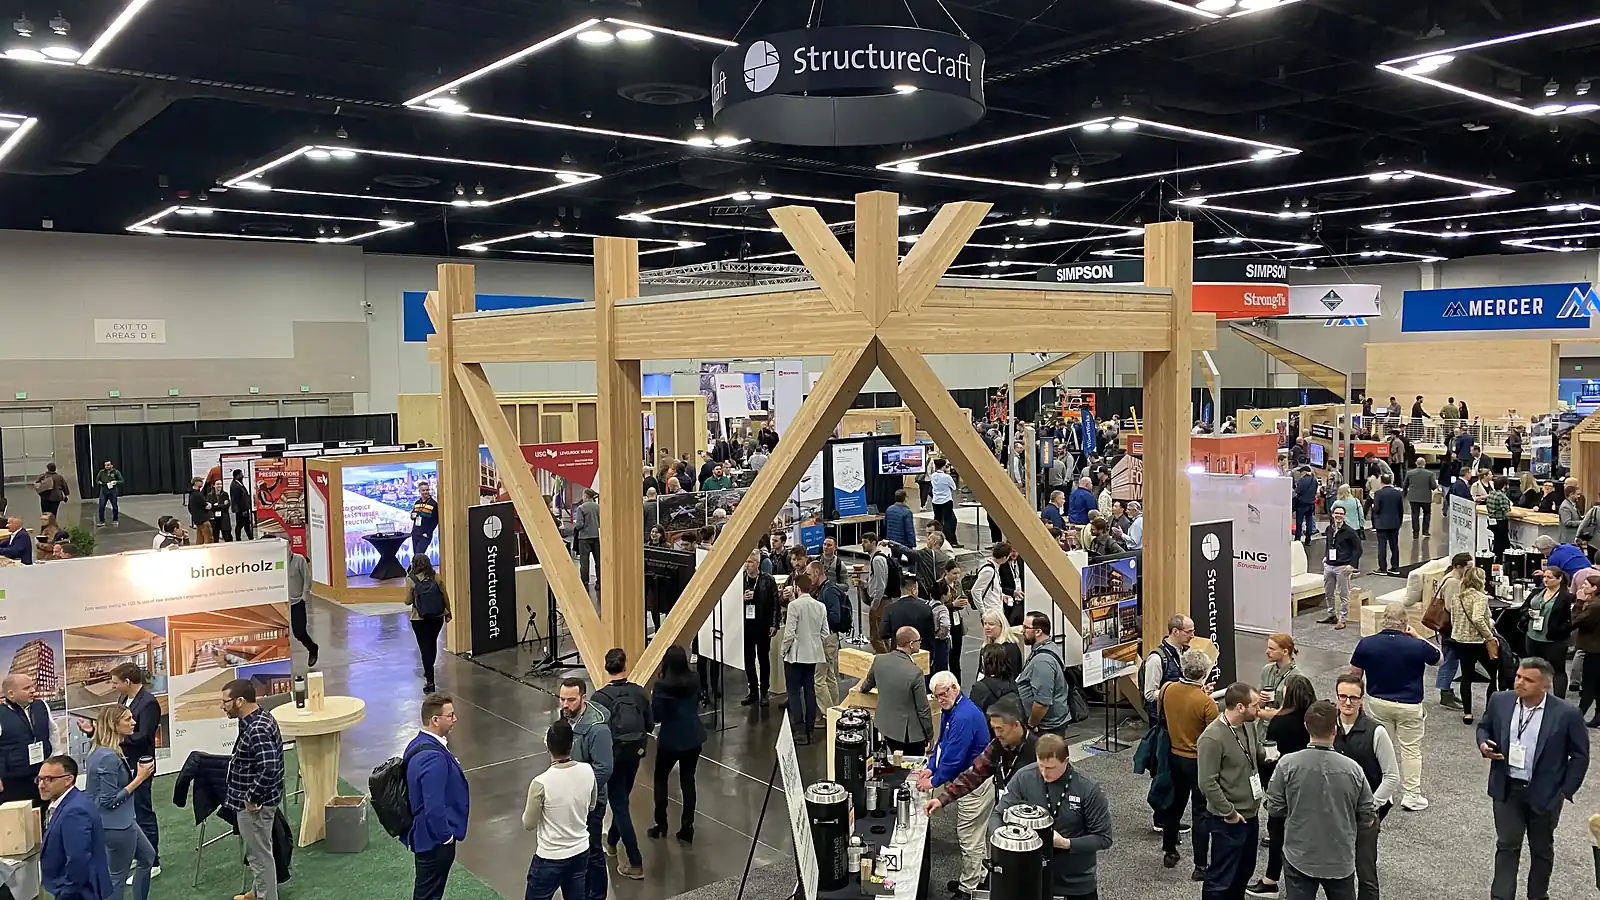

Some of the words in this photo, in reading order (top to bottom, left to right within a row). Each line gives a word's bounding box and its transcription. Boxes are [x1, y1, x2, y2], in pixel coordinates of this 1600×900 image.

[793, 43, 972, 82] StructureCraft
[1056, 264, 1114, 282] SIMPSON
[1246, 264, 1287, 279] SIMPSON
[1469, 297, 1543, 316] MERCER
[191, 560, 272, 578] binderholz
[1236, 561, 1267, 570] Structural
[487, 545, 501, 638] StructureCraft
